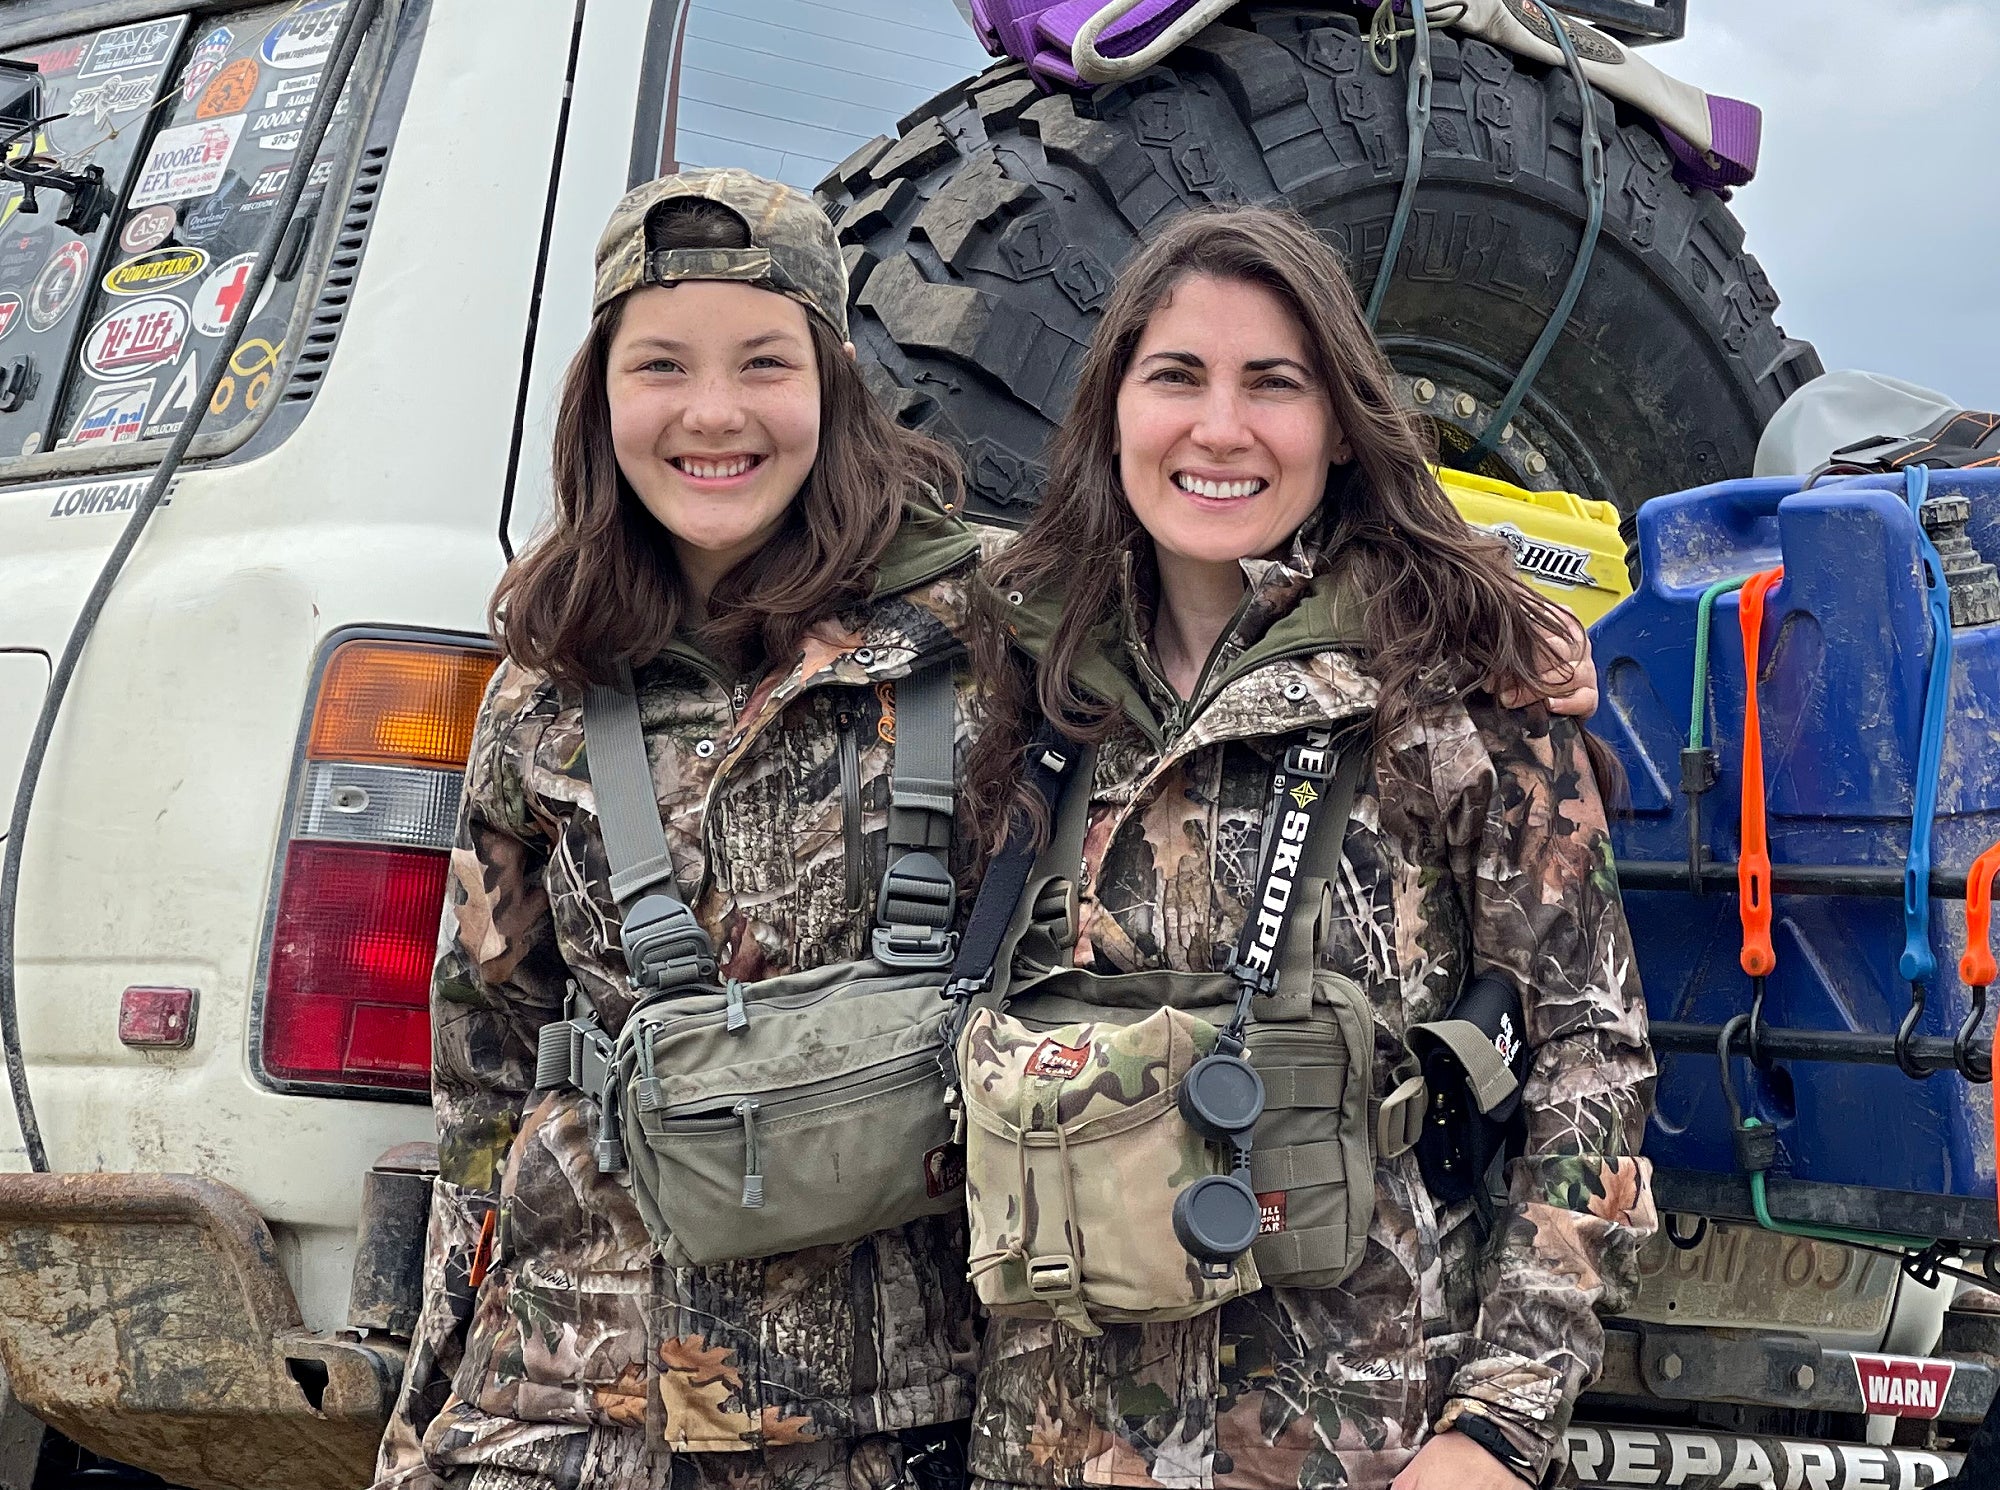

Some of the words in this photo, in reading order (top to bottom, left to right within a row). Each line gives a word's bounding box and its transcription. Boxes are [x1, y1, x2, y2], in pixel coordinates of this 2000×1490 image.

[252, 109, 296, 131] DOOR
[149, 144, 206, 172] MOORE
[141, 170, 174, 193] EFX
[126, 213, 169, 247] CASE
[191, 208, 227, 225] Overland
[115, 255, 197, 285] POWERTANK
[97, 310, 174, 361] Hi-Lift
[1520, 545, 1585, 575] BULL
[1246, 809, 1311, 975] SKOPE
[1260, 1206, 1280, 1217] ILL
[1868, 1374, 1938, 1408] WARN
